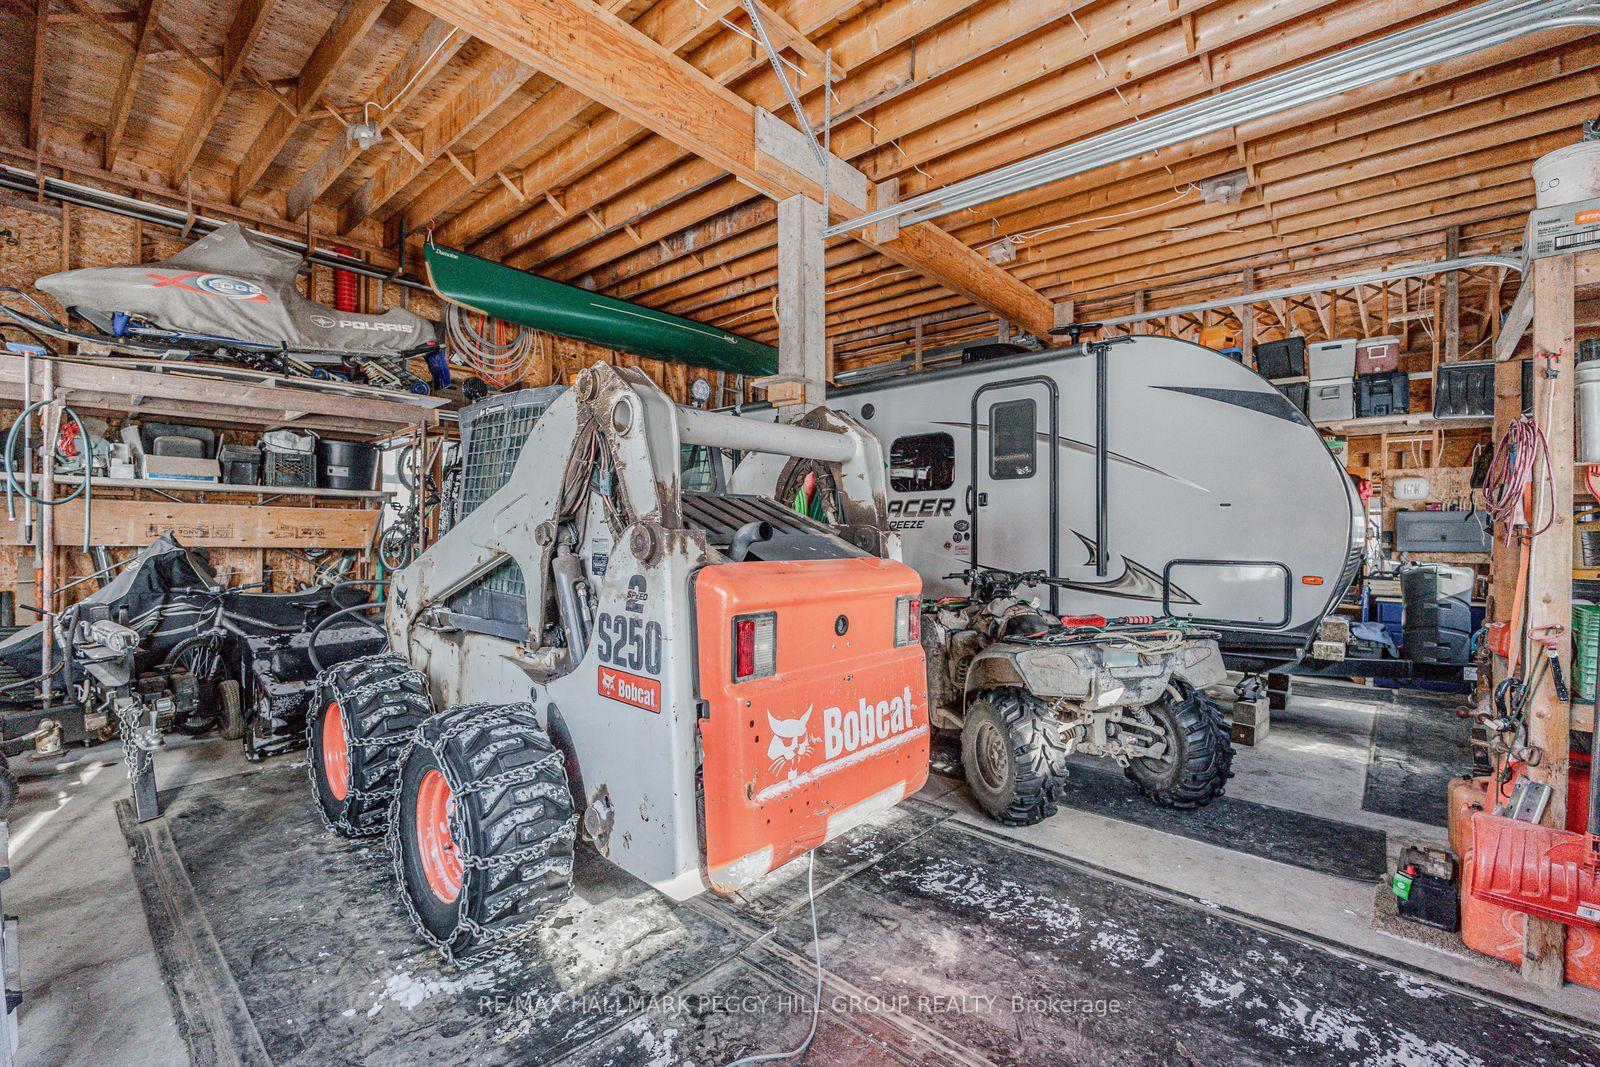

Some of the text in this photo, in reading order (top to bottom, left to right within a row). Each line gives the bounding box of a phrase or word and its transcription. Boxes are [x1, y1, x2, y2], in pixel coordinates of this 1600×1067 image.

[1537, 218, 1561, 226] Premium
[340, 320, 414, 334] POLARIS
[887, 497, 956, 517] ACER
[626, 590, 649, 601] SPEED
[597, 612, 663, 676] S250
[618, 678, 656, 708] Bobcat
[823, 686, 914, 761] Bobcat
